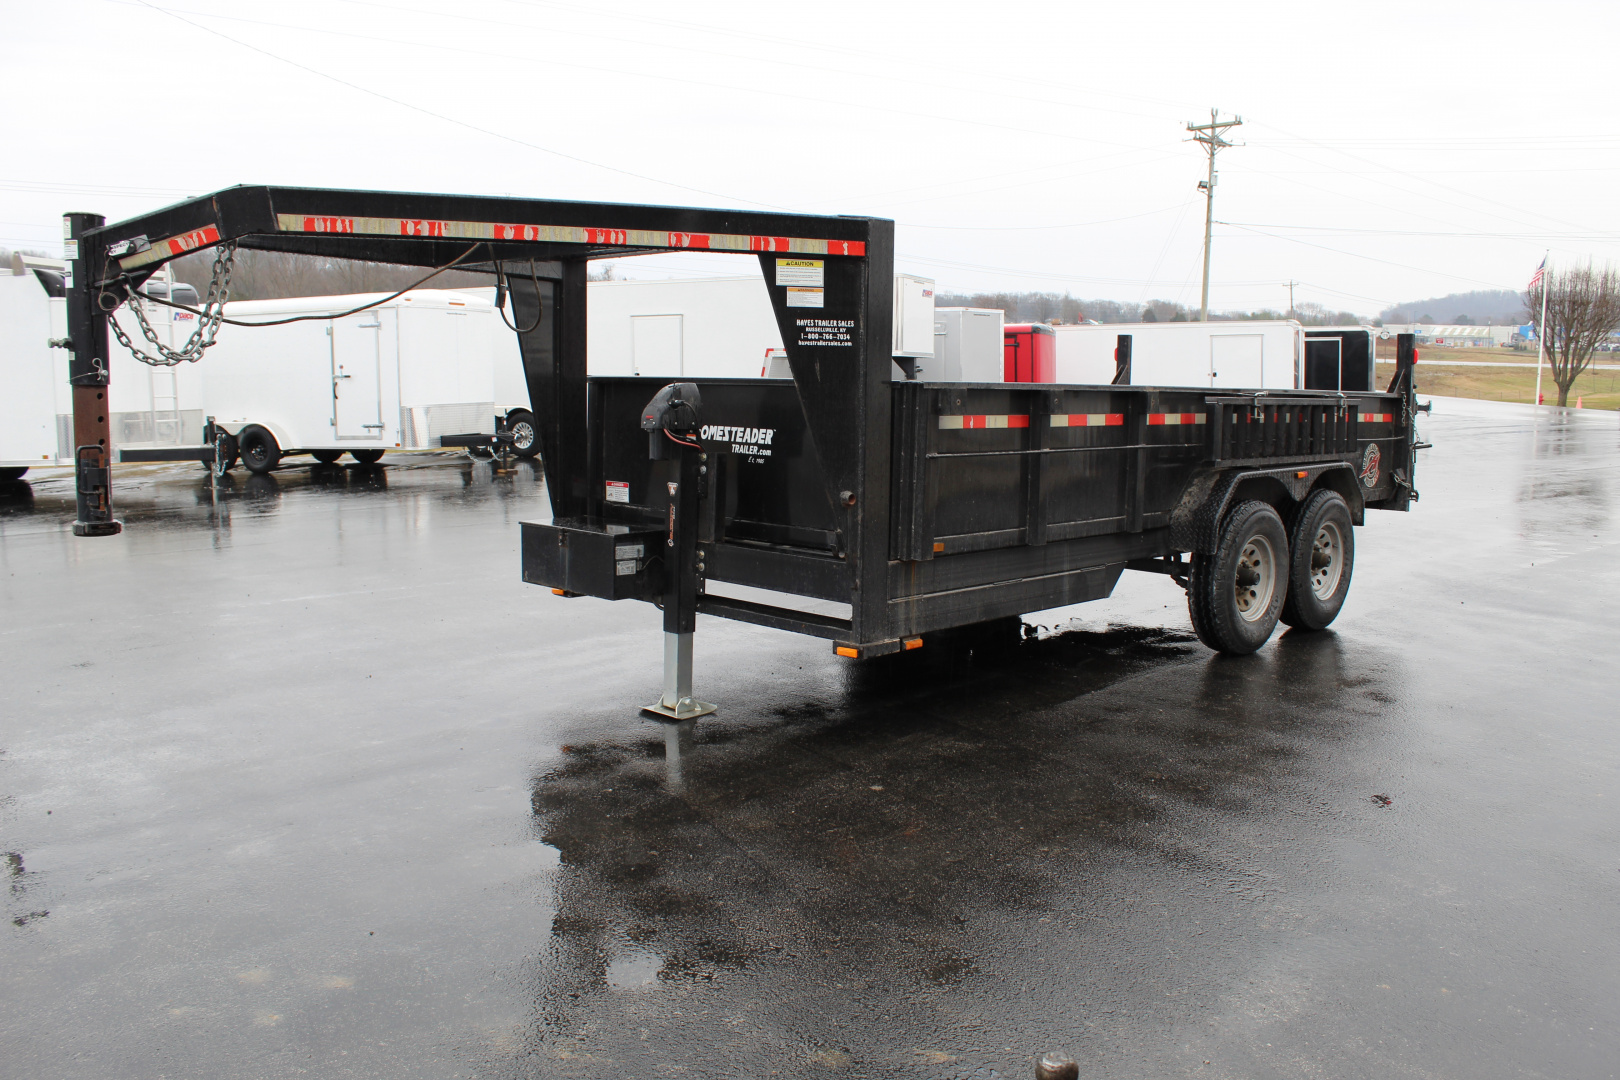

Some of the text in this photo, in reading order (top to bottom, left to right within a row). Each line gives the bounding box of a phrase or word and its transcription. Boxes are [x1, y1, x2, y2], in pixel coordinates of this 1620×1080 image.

[796, 319, 855, 328] HAYES TRAILER SALES
[699, 425, 774, 444] OMESTEADER
[732, 444, 772, 456] TRAILER.com
